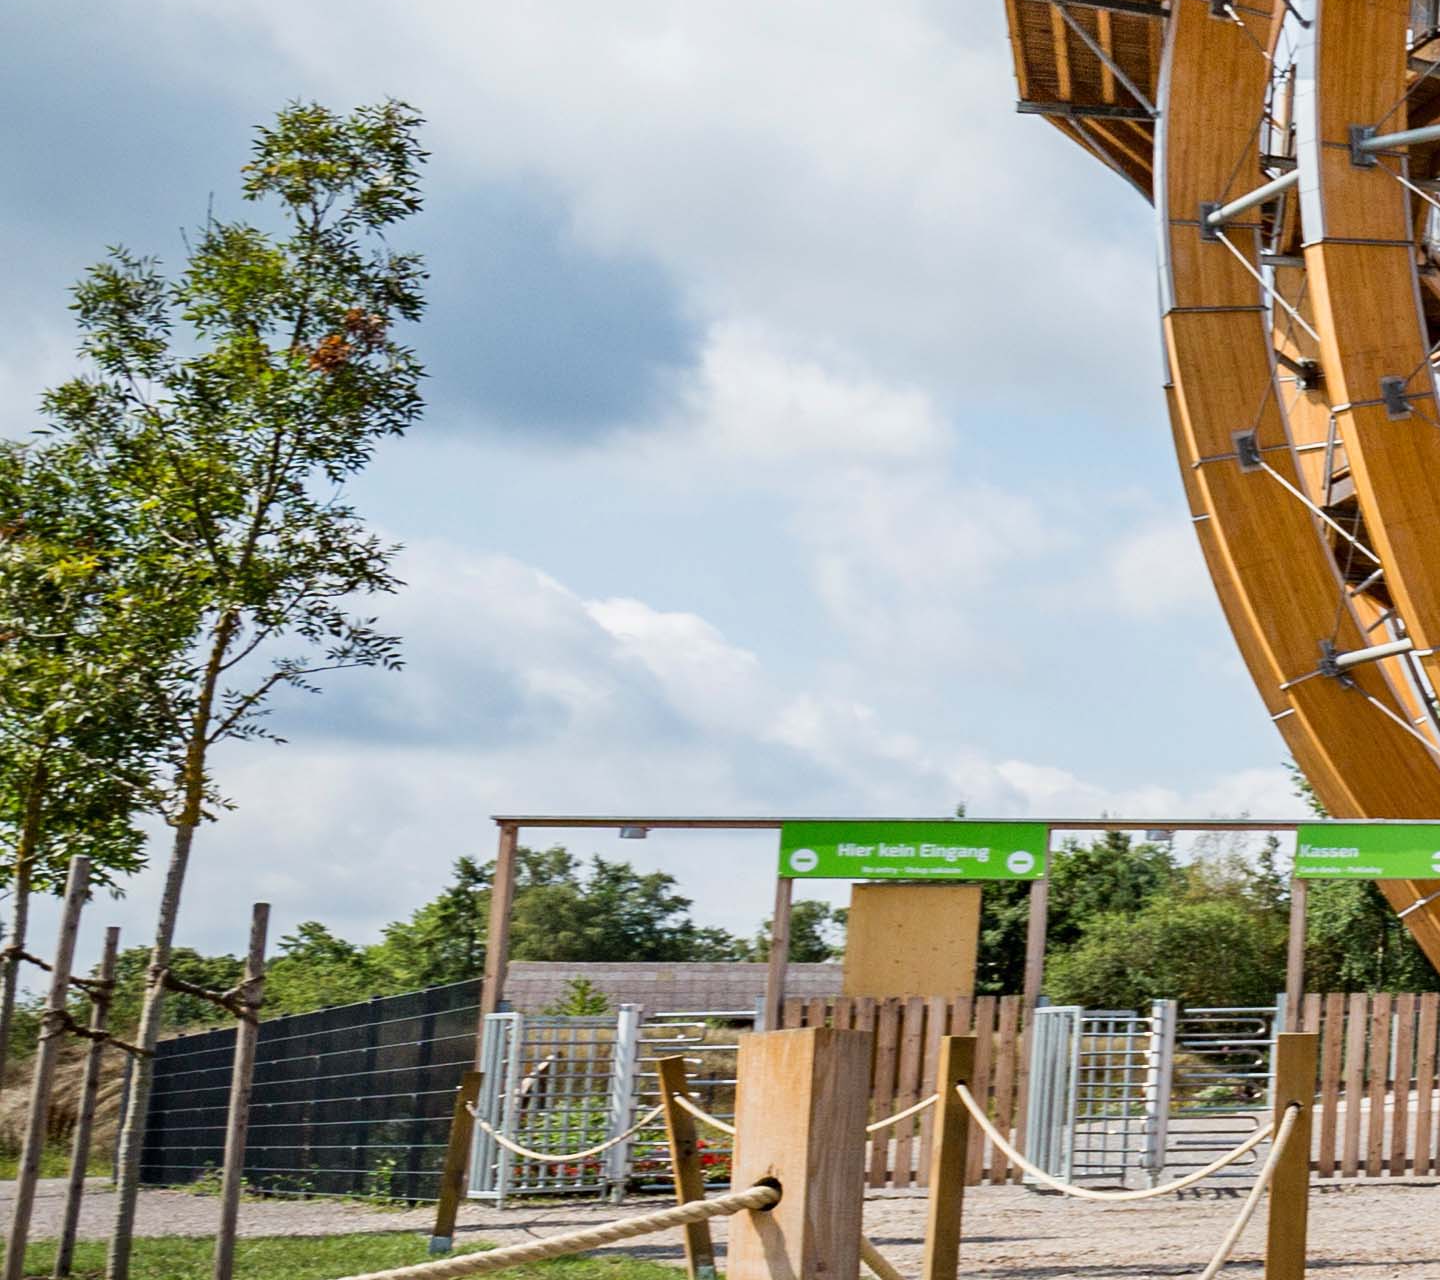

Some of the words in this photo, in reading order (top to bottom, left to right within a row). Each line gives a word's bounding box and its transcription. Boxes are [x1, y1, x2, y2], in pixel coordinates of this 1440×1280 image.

[837, 843, 874, 858] Hier
[877, 842, 915, 858] kein
[919, 843, 990, 862] Eingang
[1299, 844, 1360, 858] Kassen
